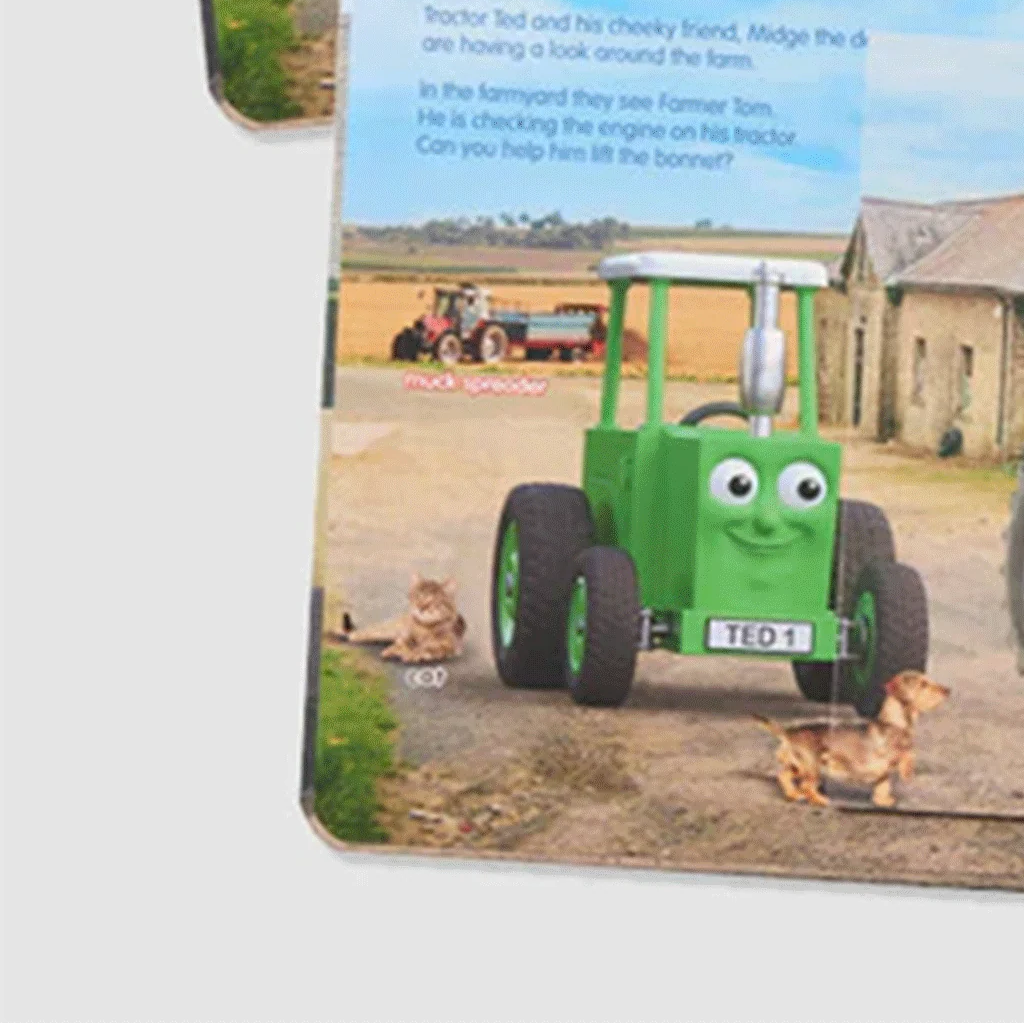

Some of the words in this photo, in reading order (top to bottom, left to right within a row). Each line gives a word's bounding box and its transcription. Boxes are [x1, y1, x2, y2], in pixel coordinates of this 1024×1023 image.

[424, 5, 488, 27] Tractor
[494, 9, 526, 30] Ted
[531, 14, 570, 32] and
[575, 14, 602, 33] his
[608, 16, 676, 39] cheeky
[682, 20, 741, 44] friend,
[748, 24, 809, 50] Midge
[815, 28, 845, 47] the
[422, 36, 454, 53] are
[460, 35, 525, 61] having
[530, 43, 543, 58] a
[549, 41, 588, 59] look
[594, 46, 665, 65] around
[671, 49, 702, 68] the
[419, 79, 437, 99] In
[442, 81, 474, 101] the
[479, 83, 567, 108] farmyard
[572, 90, 614, 111] they
[619, 95, 653, 110] see
[659, 93, 726, 115] Farmer
[417, 109, 445, 127] He
[451, 111, 466, 128] is
[471, 111, 557, 137] checking
[562, 116, 593, 135] the
[599, 121, 666, 142] engine
[670, 125, 696, 141] on
[701, 124, 730, 144] his
[416, 134, 455, 156] Can
[461, 142, 496, 160] you
[502, 140, 544, 163] help
[549, 142, 586, 162] him
[591, 144, 614, 163] lift
[619, 146, 649, 165] the
[654, 147, 735, 169] bonnet?
[726, 624, 776, 647] TED
[784, 627, 794, 646] 1
[404, 665, 448, 690] cat
